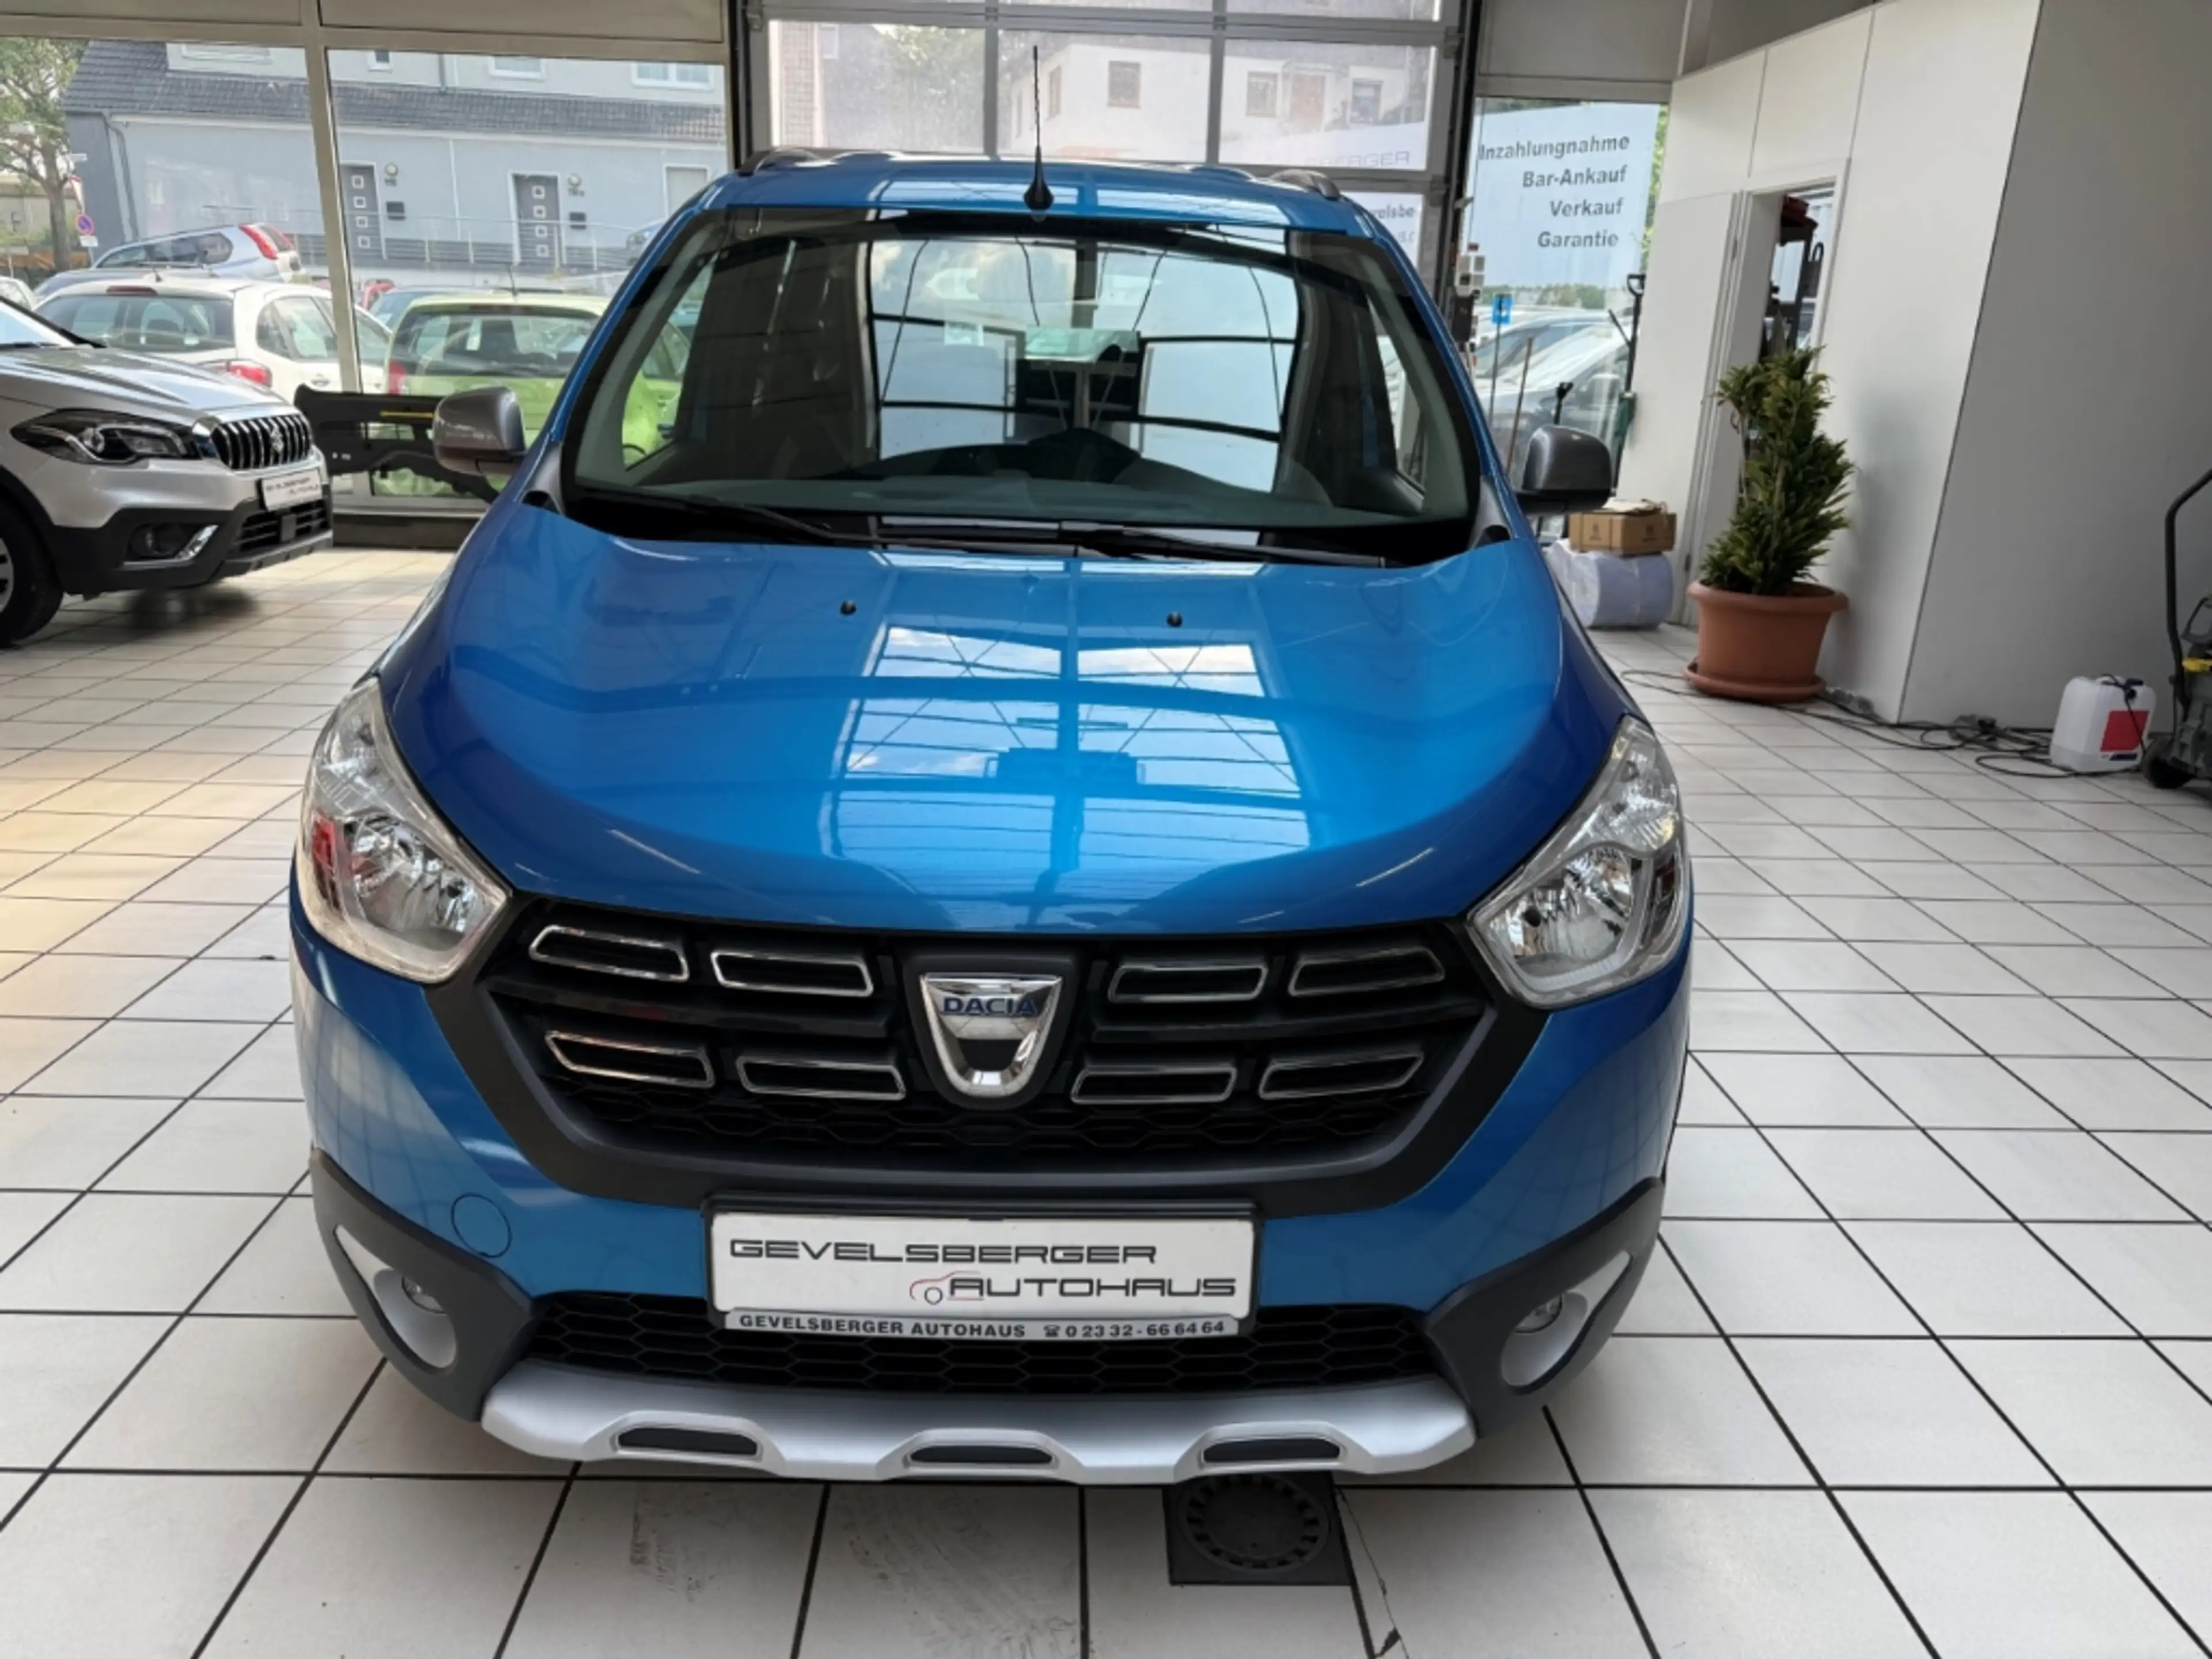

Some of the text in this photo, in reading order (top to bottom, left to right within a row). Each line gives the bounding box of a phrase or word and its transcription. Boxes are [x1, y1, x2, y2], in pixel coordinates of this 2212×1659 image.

[1479, 135, 1630, 160] Inzahlungnahme
[1522, 164, 1628, 188] Bar-Ankauf
[1550, 196, 1624, 217] Verkauf
[1537, 229, 1619, 248] Garantie
[942, 997, 1038, 1016] DACIA
[730, 1238, 1156, 1264] GEVELSBERGER
[950, 1277, 1236, 1297] AUTOHAUS
[740, 1315, 903, 1335] GEVELSBERGER
[911, 1322, 1025, 1338] AUTOHAUS
